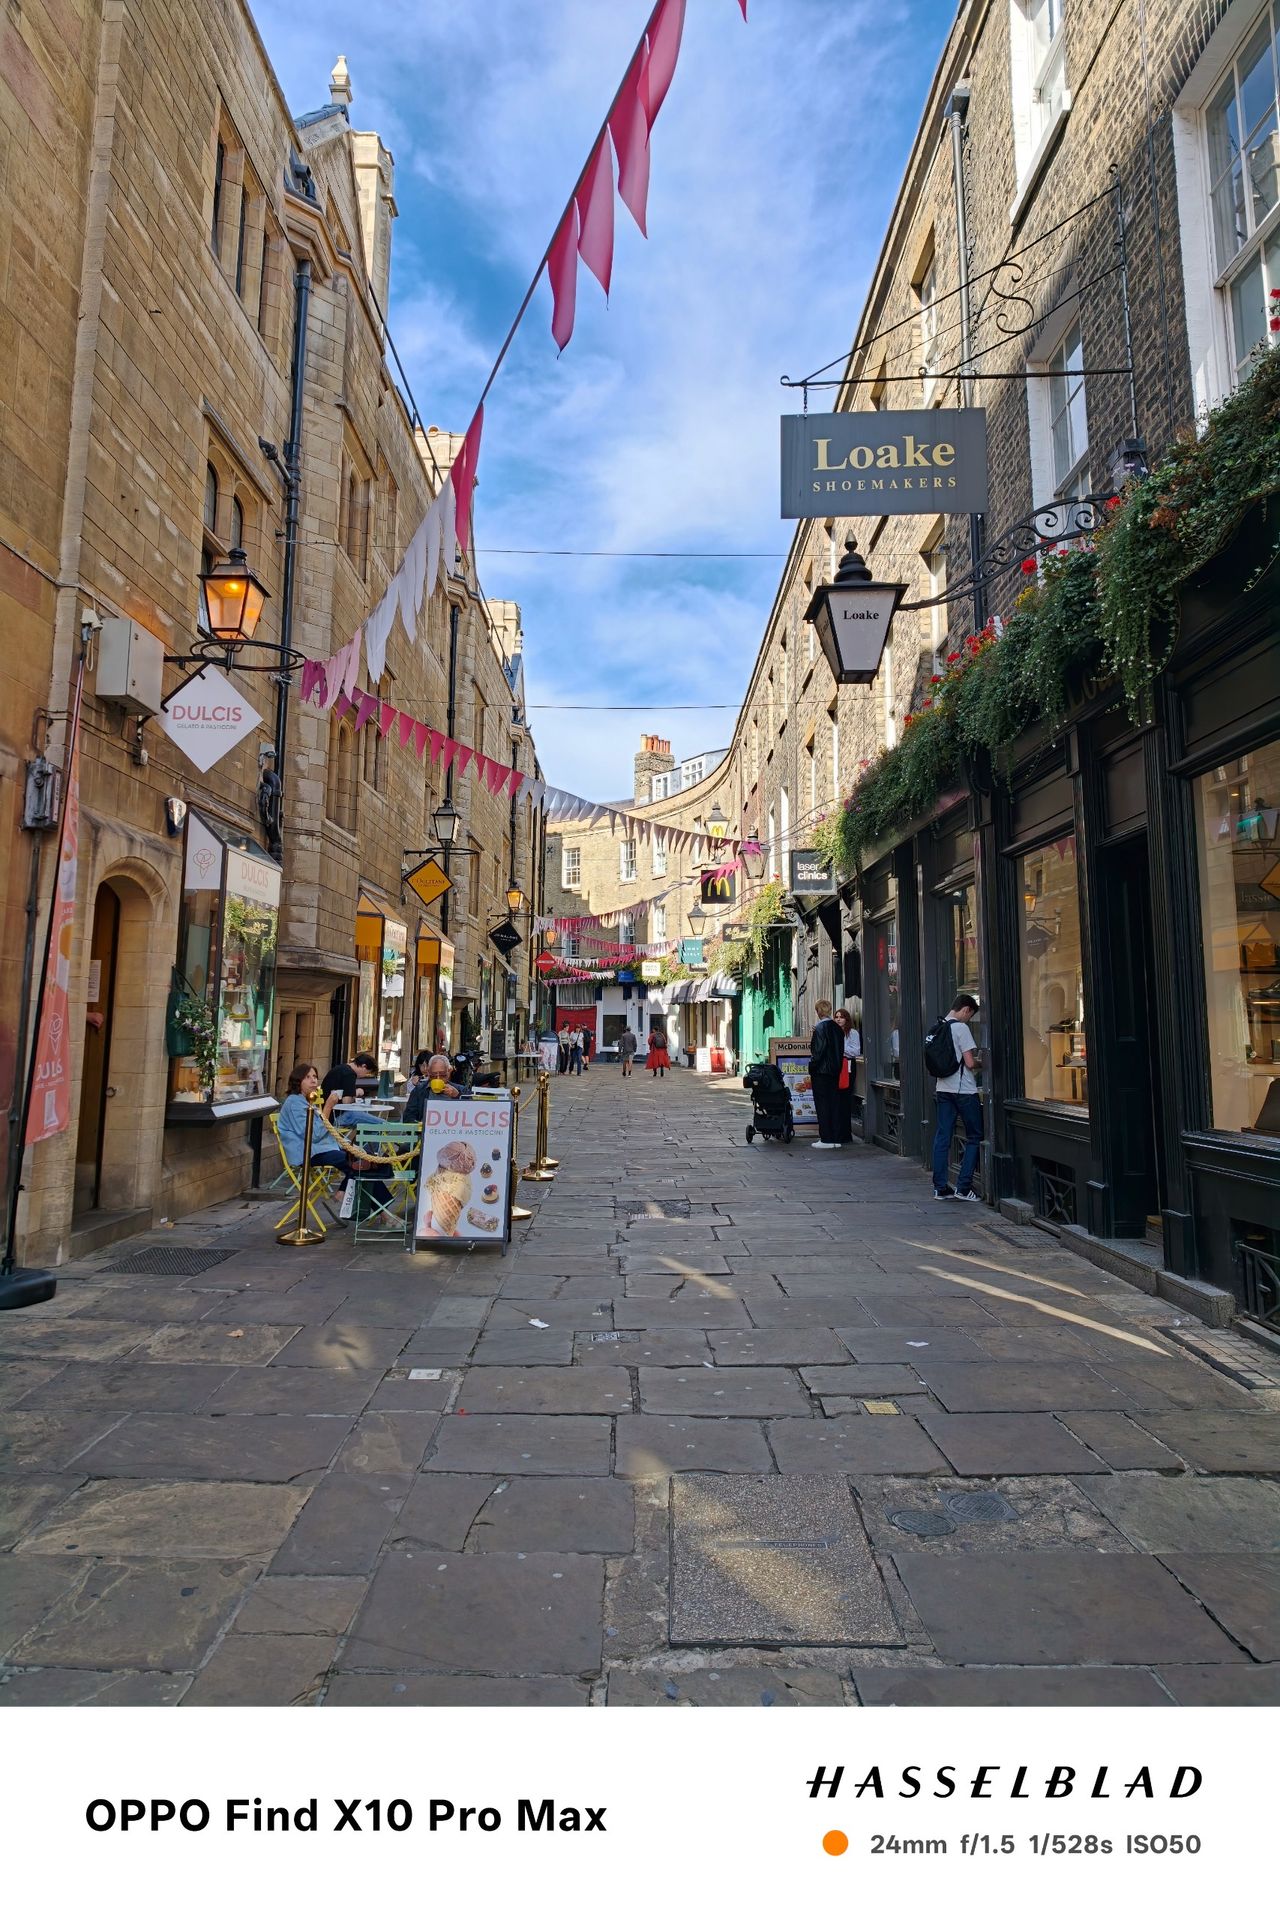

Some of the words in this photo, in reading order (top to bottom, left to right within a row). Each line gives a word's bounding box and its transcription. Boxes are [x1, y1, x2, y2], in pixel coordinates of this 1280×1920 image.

[812, 435, 956, 471] Loake
[812, 476, 956, 492] SHOEMAKERS
[843, 610, 880, 620] Loake
[172, 705, 242, 722] DULCIS
[797, 862, 819, 871] laser
[797, 870, 828, 880] clinics
[426, 1110, 510, 1128] DULCIS
